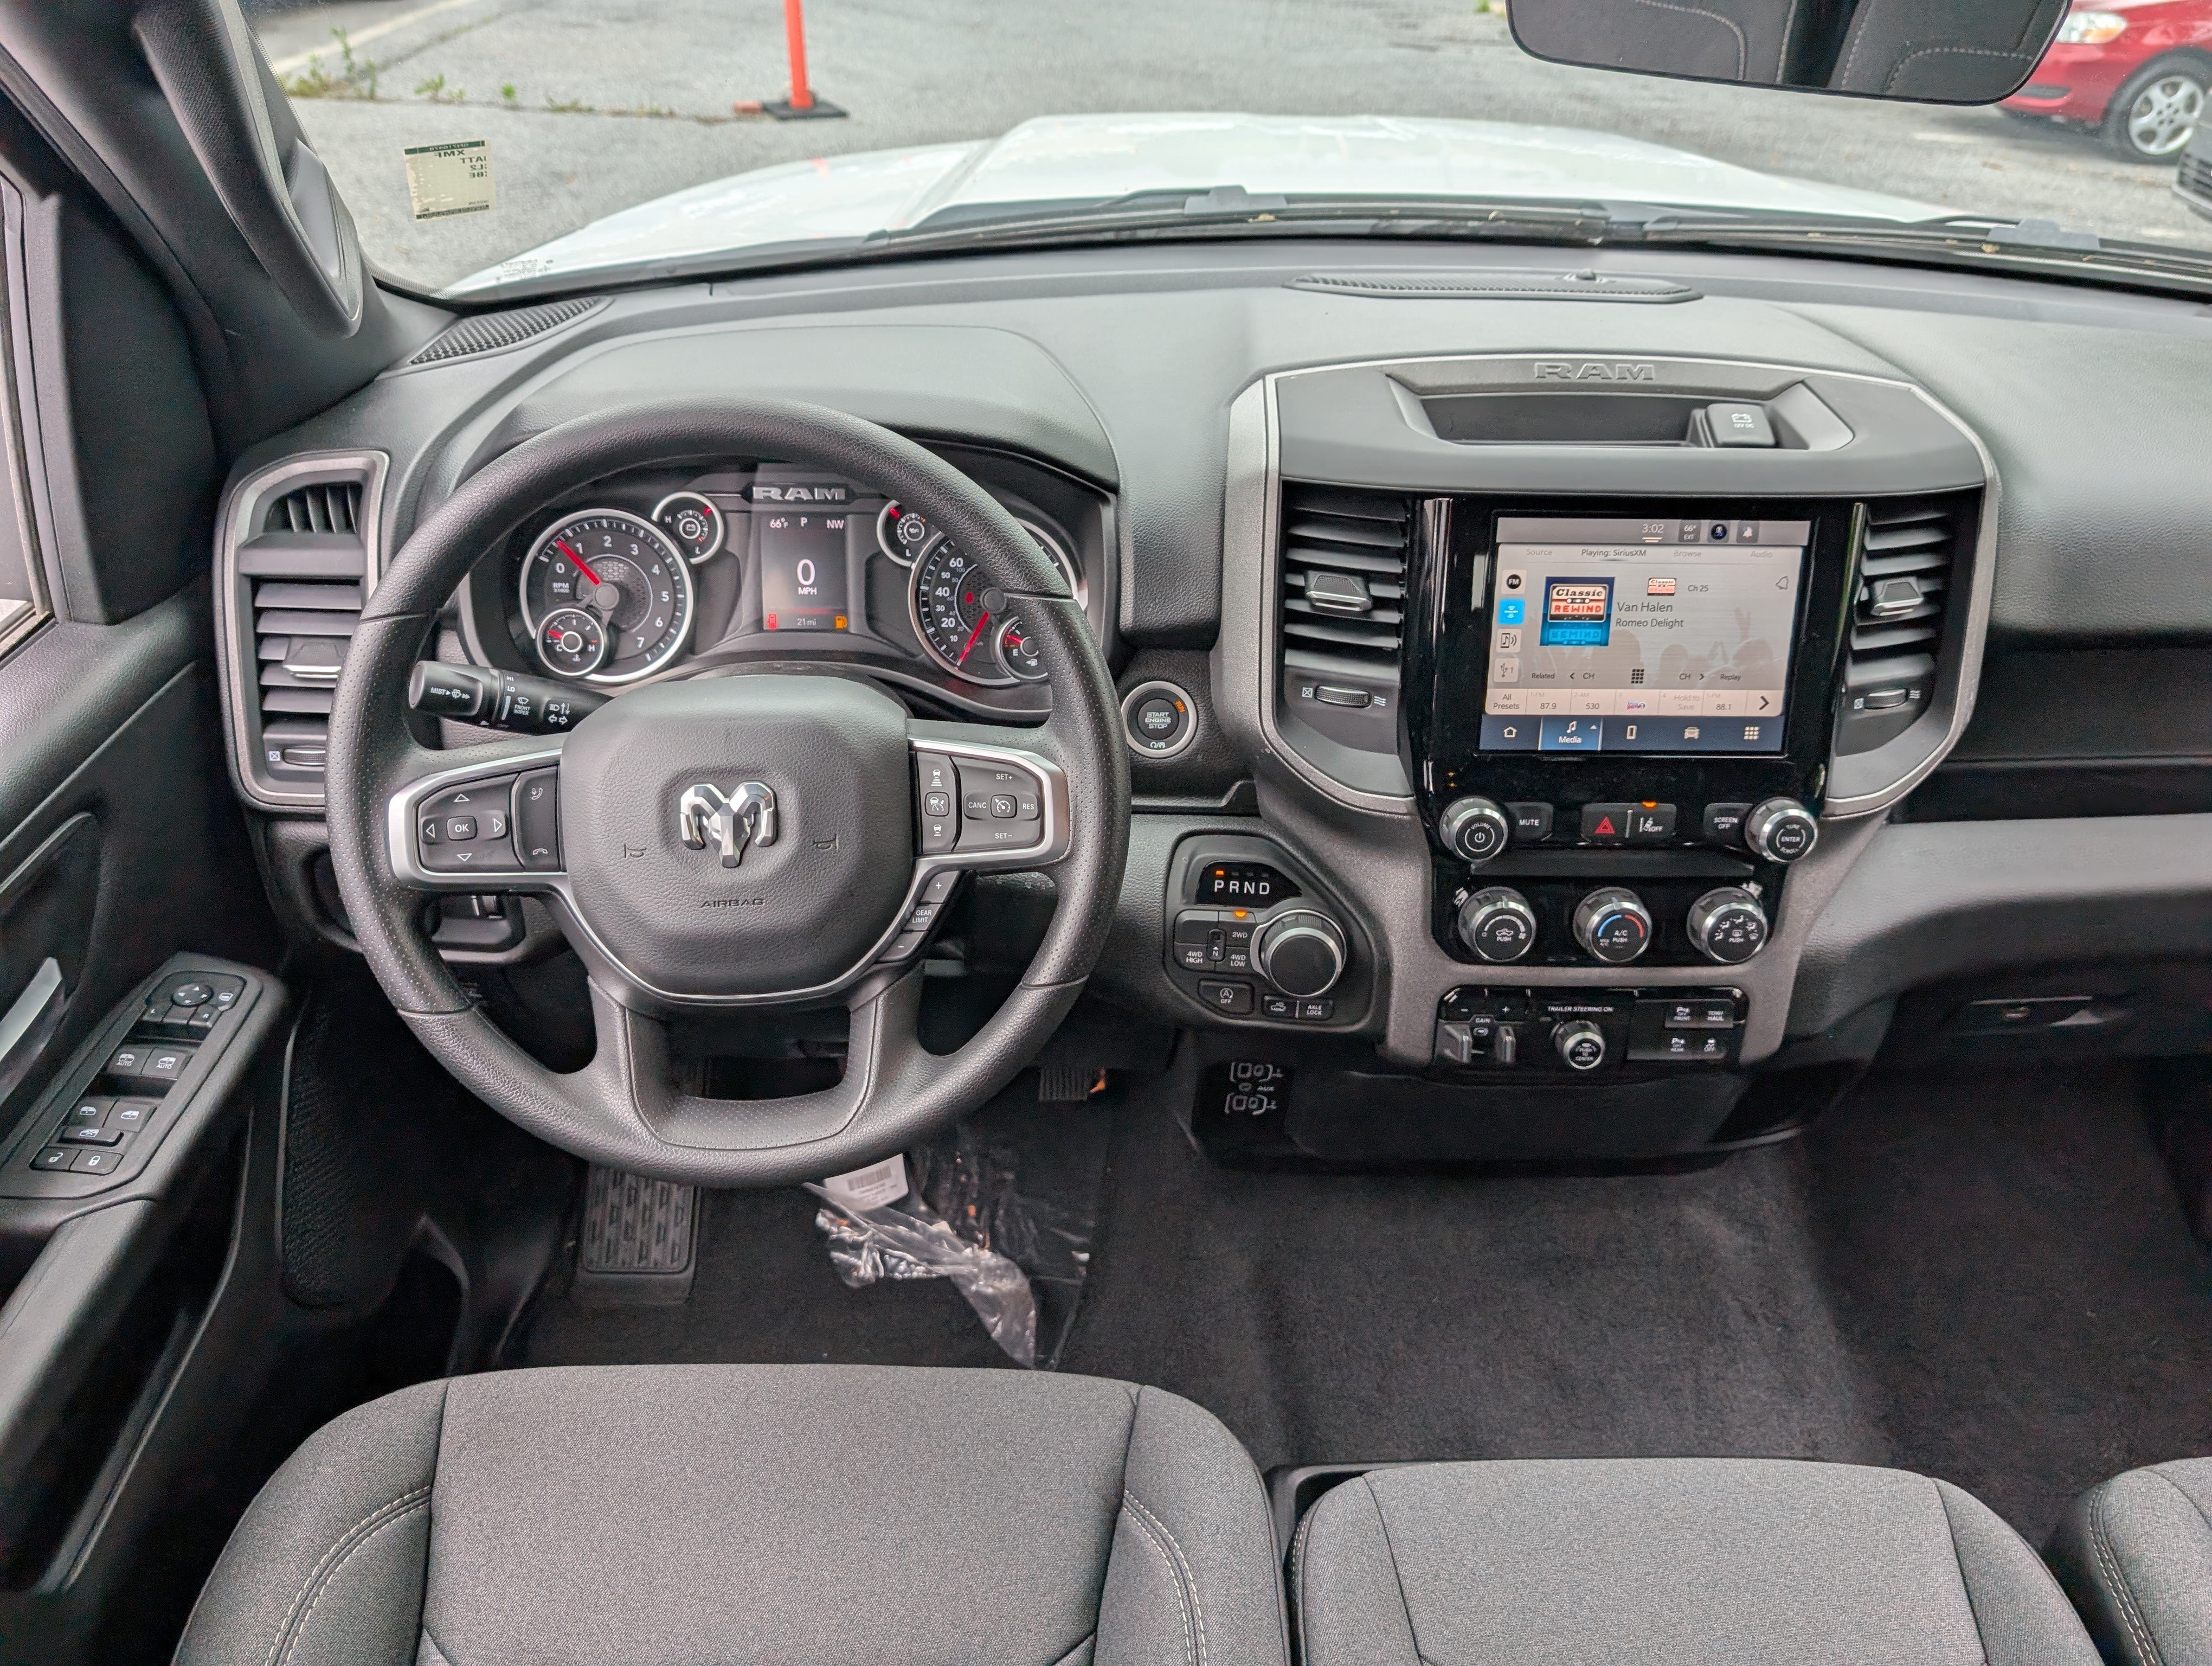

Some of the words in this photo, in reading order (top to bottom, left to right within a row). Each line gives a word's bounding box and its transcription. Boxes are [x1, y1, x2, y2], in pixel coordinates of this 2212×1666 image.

[1534, 362, 1655, 381] RAM
[753, 487, 846, 500] RAM
[664, 515, 672, 523] H
[800, 517, 807, 527] P
[827, 519, 844, 529] NW
[1642, 524, 1664, 534] 3:02
[603, 535, 612, 547] 2
[576, 543, 583, 554] 1
[631, 544, 639, 555] 3
[695, 546, 700, 554] L
[1581, 549, 1611, 558] Playing:
[1613, 549, 1647, 557] SiriusXM
[1750, 550, 1773, 558] Audio
[949, 558, 963, 567] 60
[556, 562, 565, 574] 0
[652, 564, 660, 575] 4
[797, 559, 815, 585] 0
[798, 587, 817, 595] MPH
[935, 587, 950, 597] 40
[1555, 588, 1603, 597] Classic
[661, 591, 670, 602] 5
[1554, 605, 1602, 613] REWIND
[1617, 602, 1637, 612] Van
[1641, 602, 1673, 612] Halen
[655, 617, 663, 627] 6
[941, 618, 955, 627] 20
[1616, 618, 1648, 627] Romeo
[1650, 618, 1684, 629] Delight
[636, 637, 645, 648] 7
[430, 687, 446, 696] MIST
[455, 823, 469, 832] OK
[1214, 880, 1224, 893] P
[1229, 880, 1240, 893] R
[1244, 881, 1255, 894] N
[1259, 882, 1270, 895] D
[700, 899, 764, 908] AIRBAG
